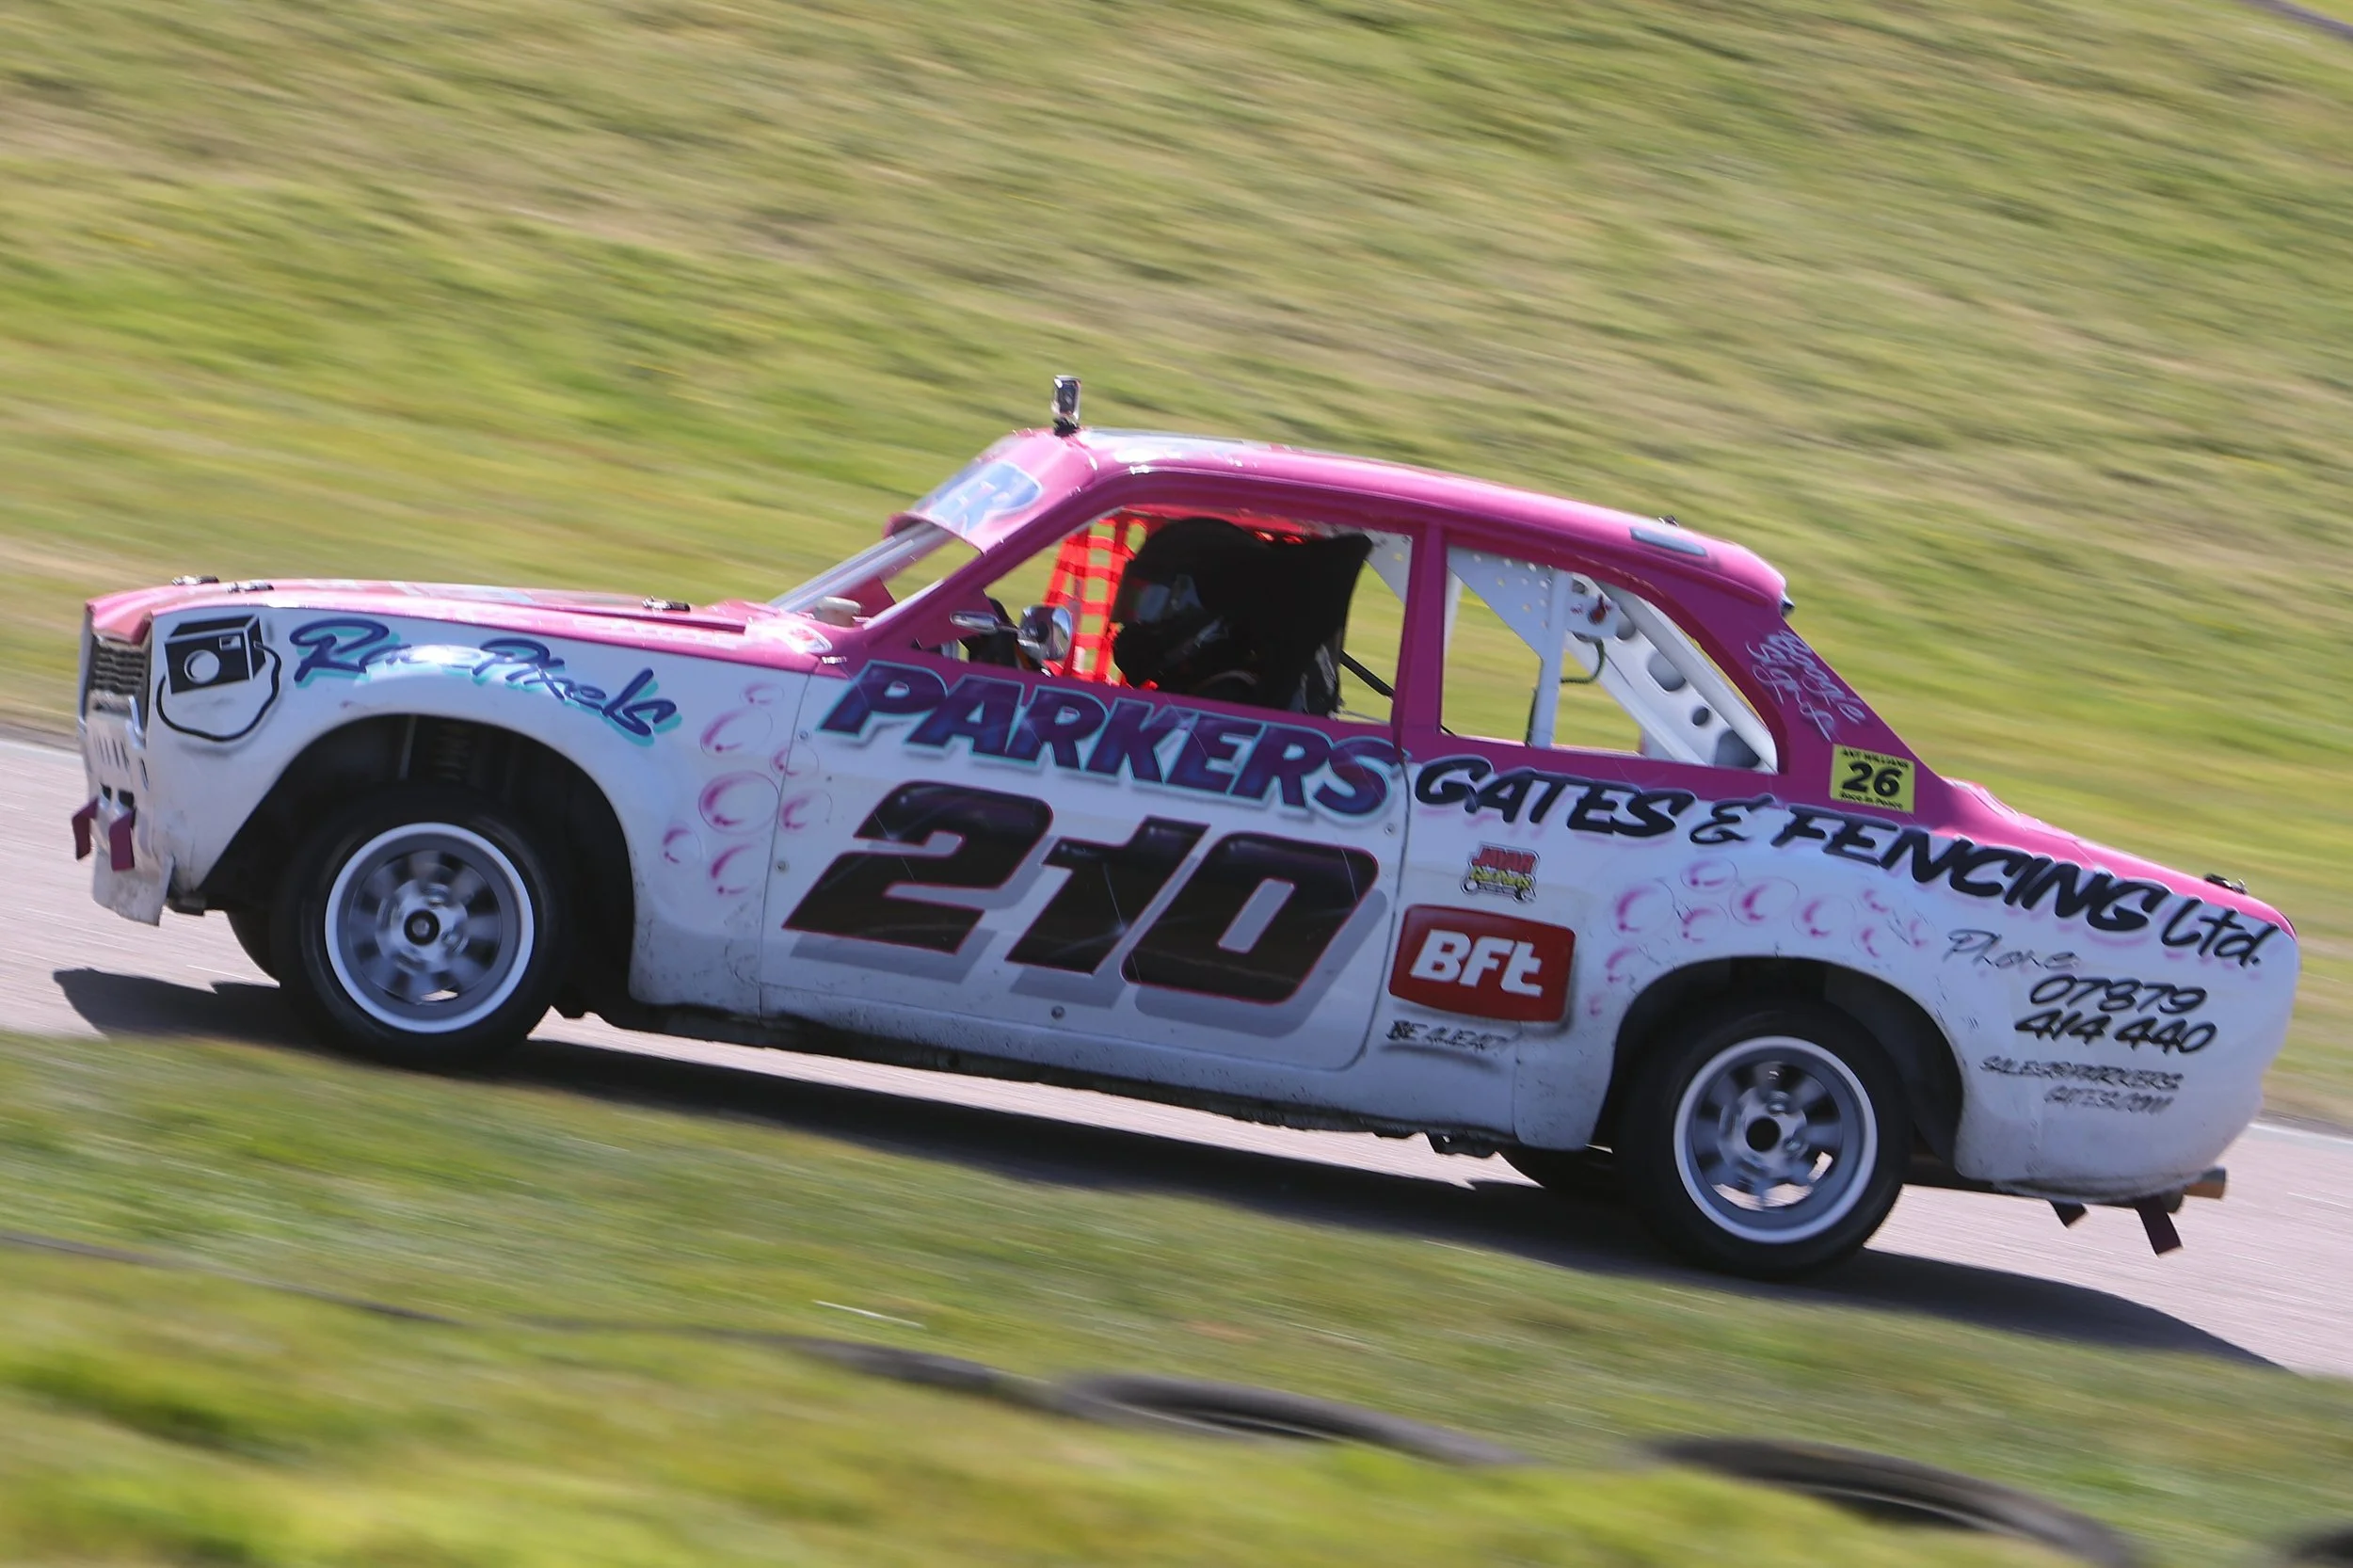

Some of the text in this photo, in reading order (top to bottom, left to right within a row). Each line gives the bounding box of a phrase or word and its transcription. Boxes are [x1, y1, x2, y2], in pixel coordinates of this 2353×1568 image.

[472, 638, 679, 741] Pixels
[818, 660, 1405, 817] PARKERS
[1840, 760, 1903, 797] 26
[781, 780, 1379, 1004] 210
[1415, 754, 1694, 838] GATES
[1689, 793, 1773, 845] &
[1770, 805, 2171, 935] FENCING
[2029, 974, 2208, 1015] 07879
